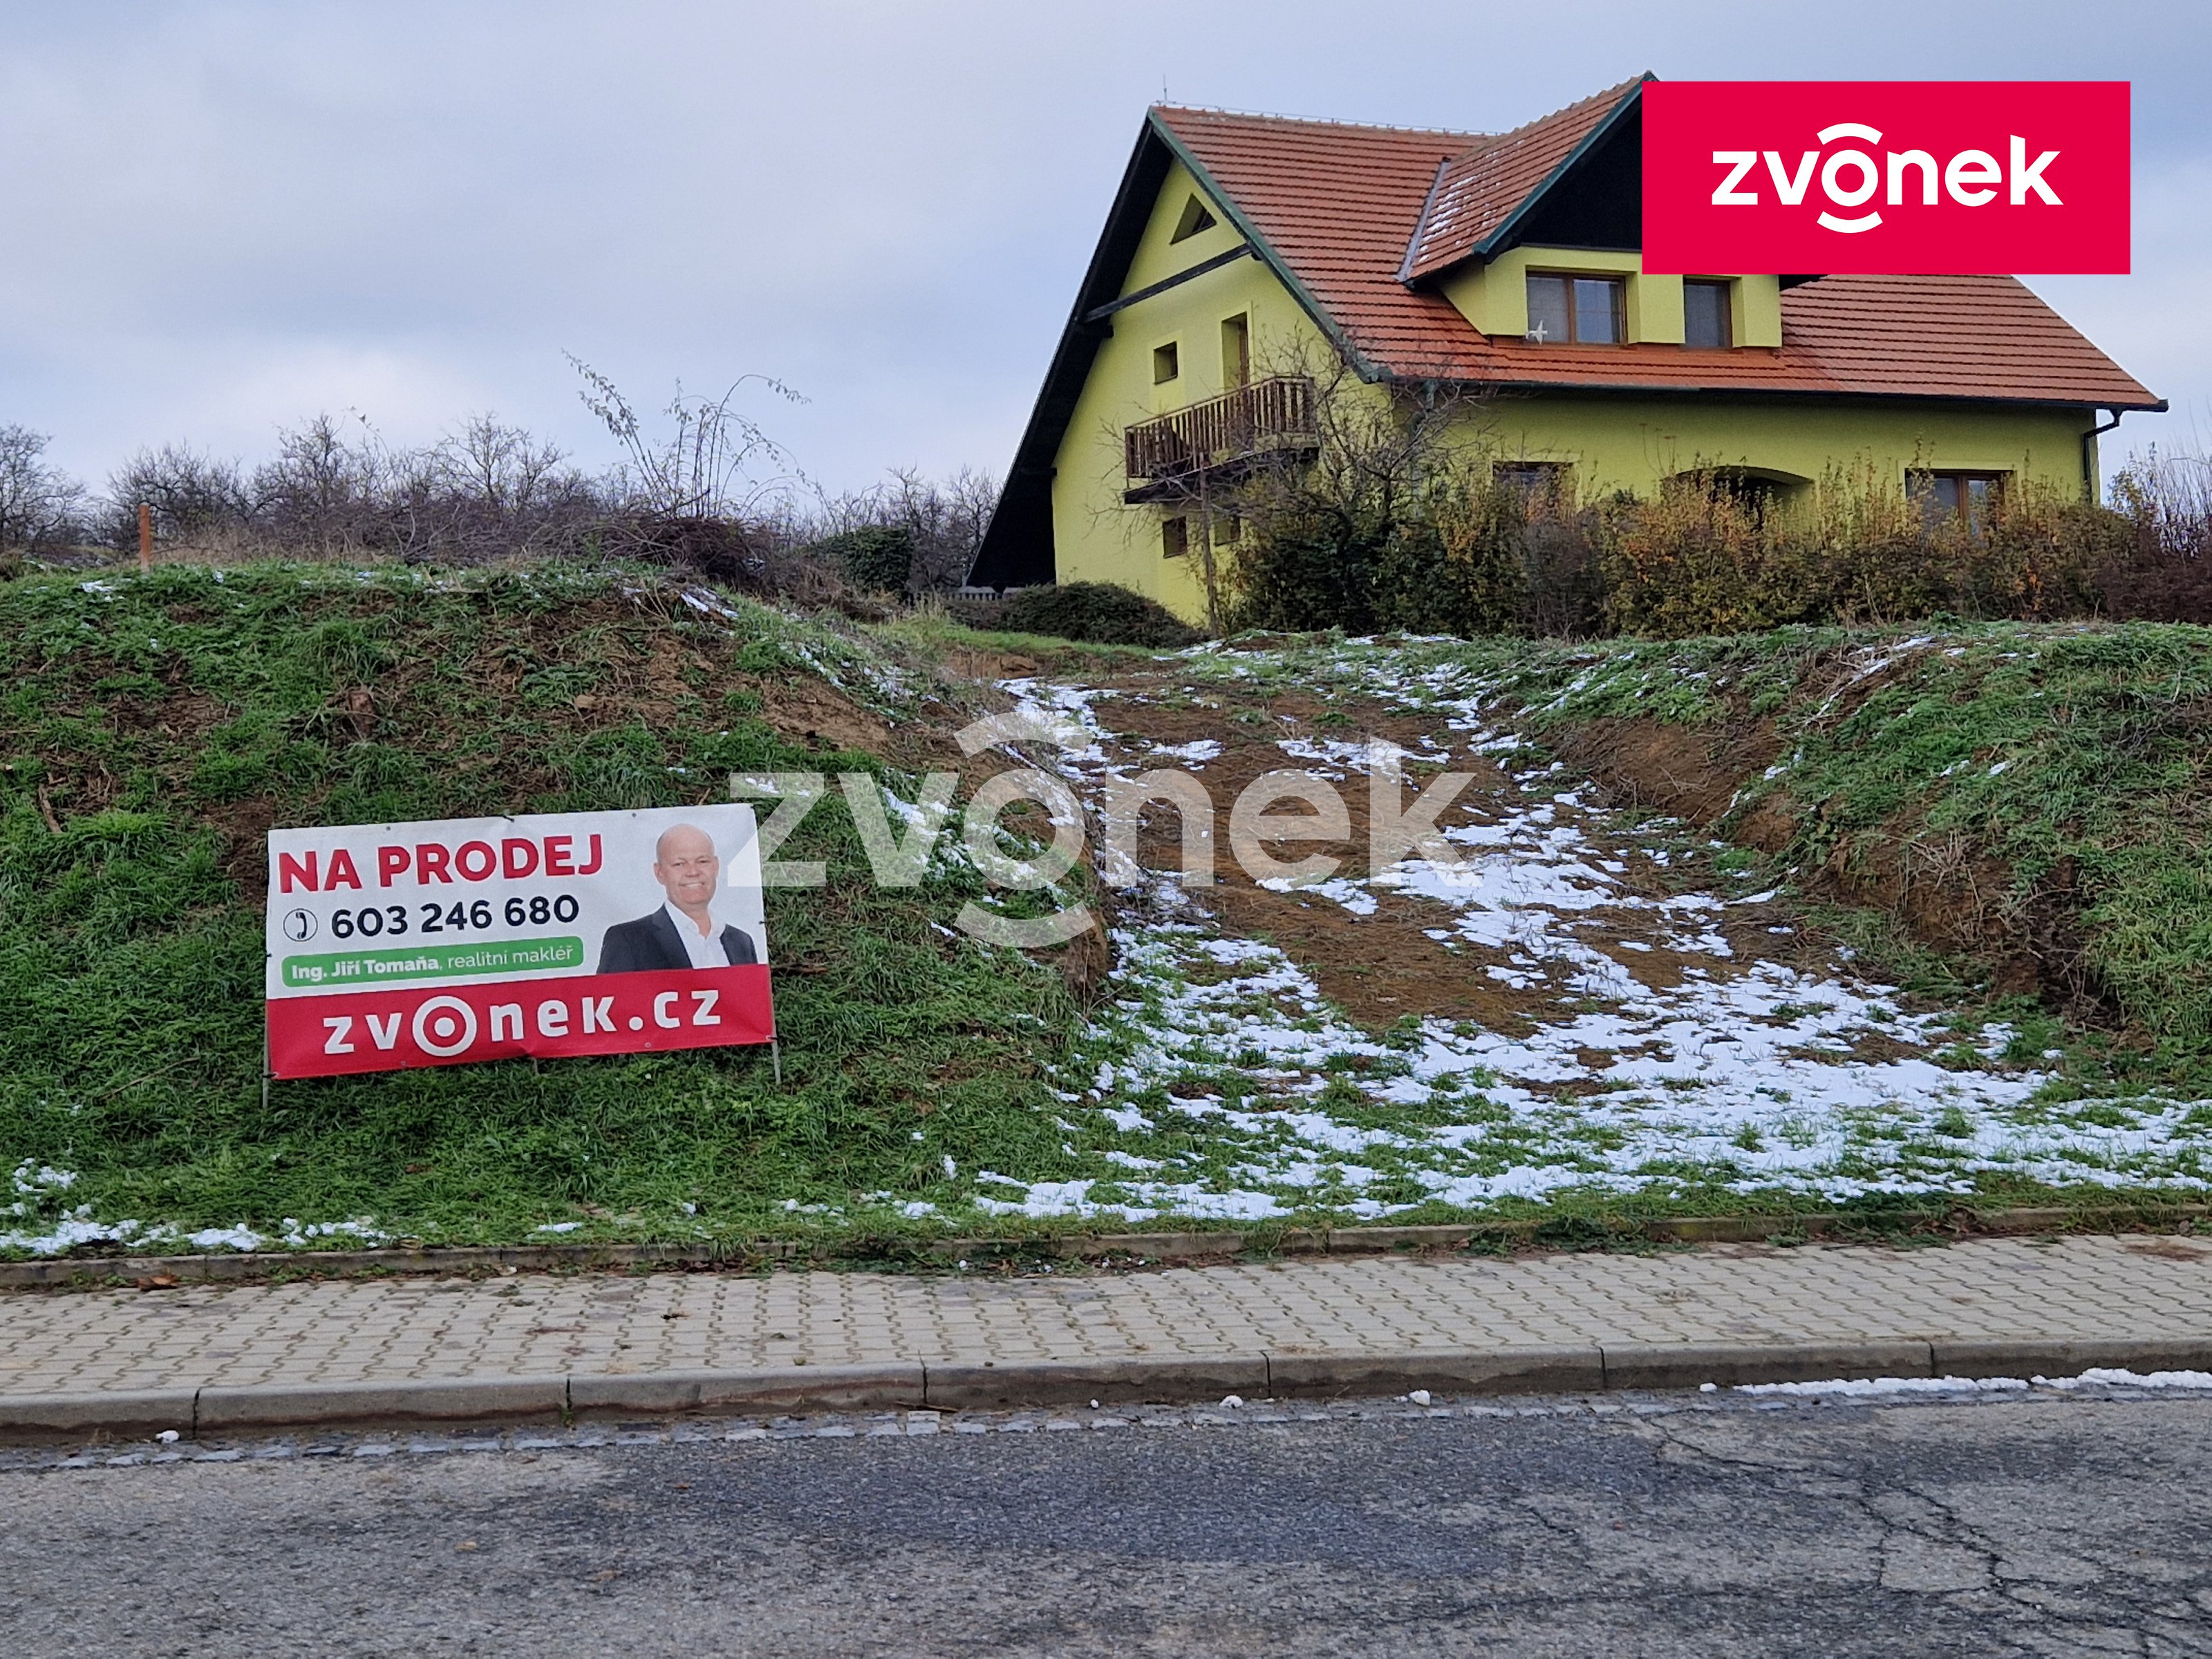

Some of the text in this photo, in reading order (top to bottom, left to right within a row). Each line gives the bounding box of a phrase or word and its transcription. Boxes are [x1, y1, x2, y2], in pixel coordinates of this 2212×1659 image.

[279, 834, 602, 893] NA PRODEJ
[331, 894, 579, 938] 603 246 680
[292, 944, 573, 982] Ing. Jiří Tomaňa, realitní makléř
